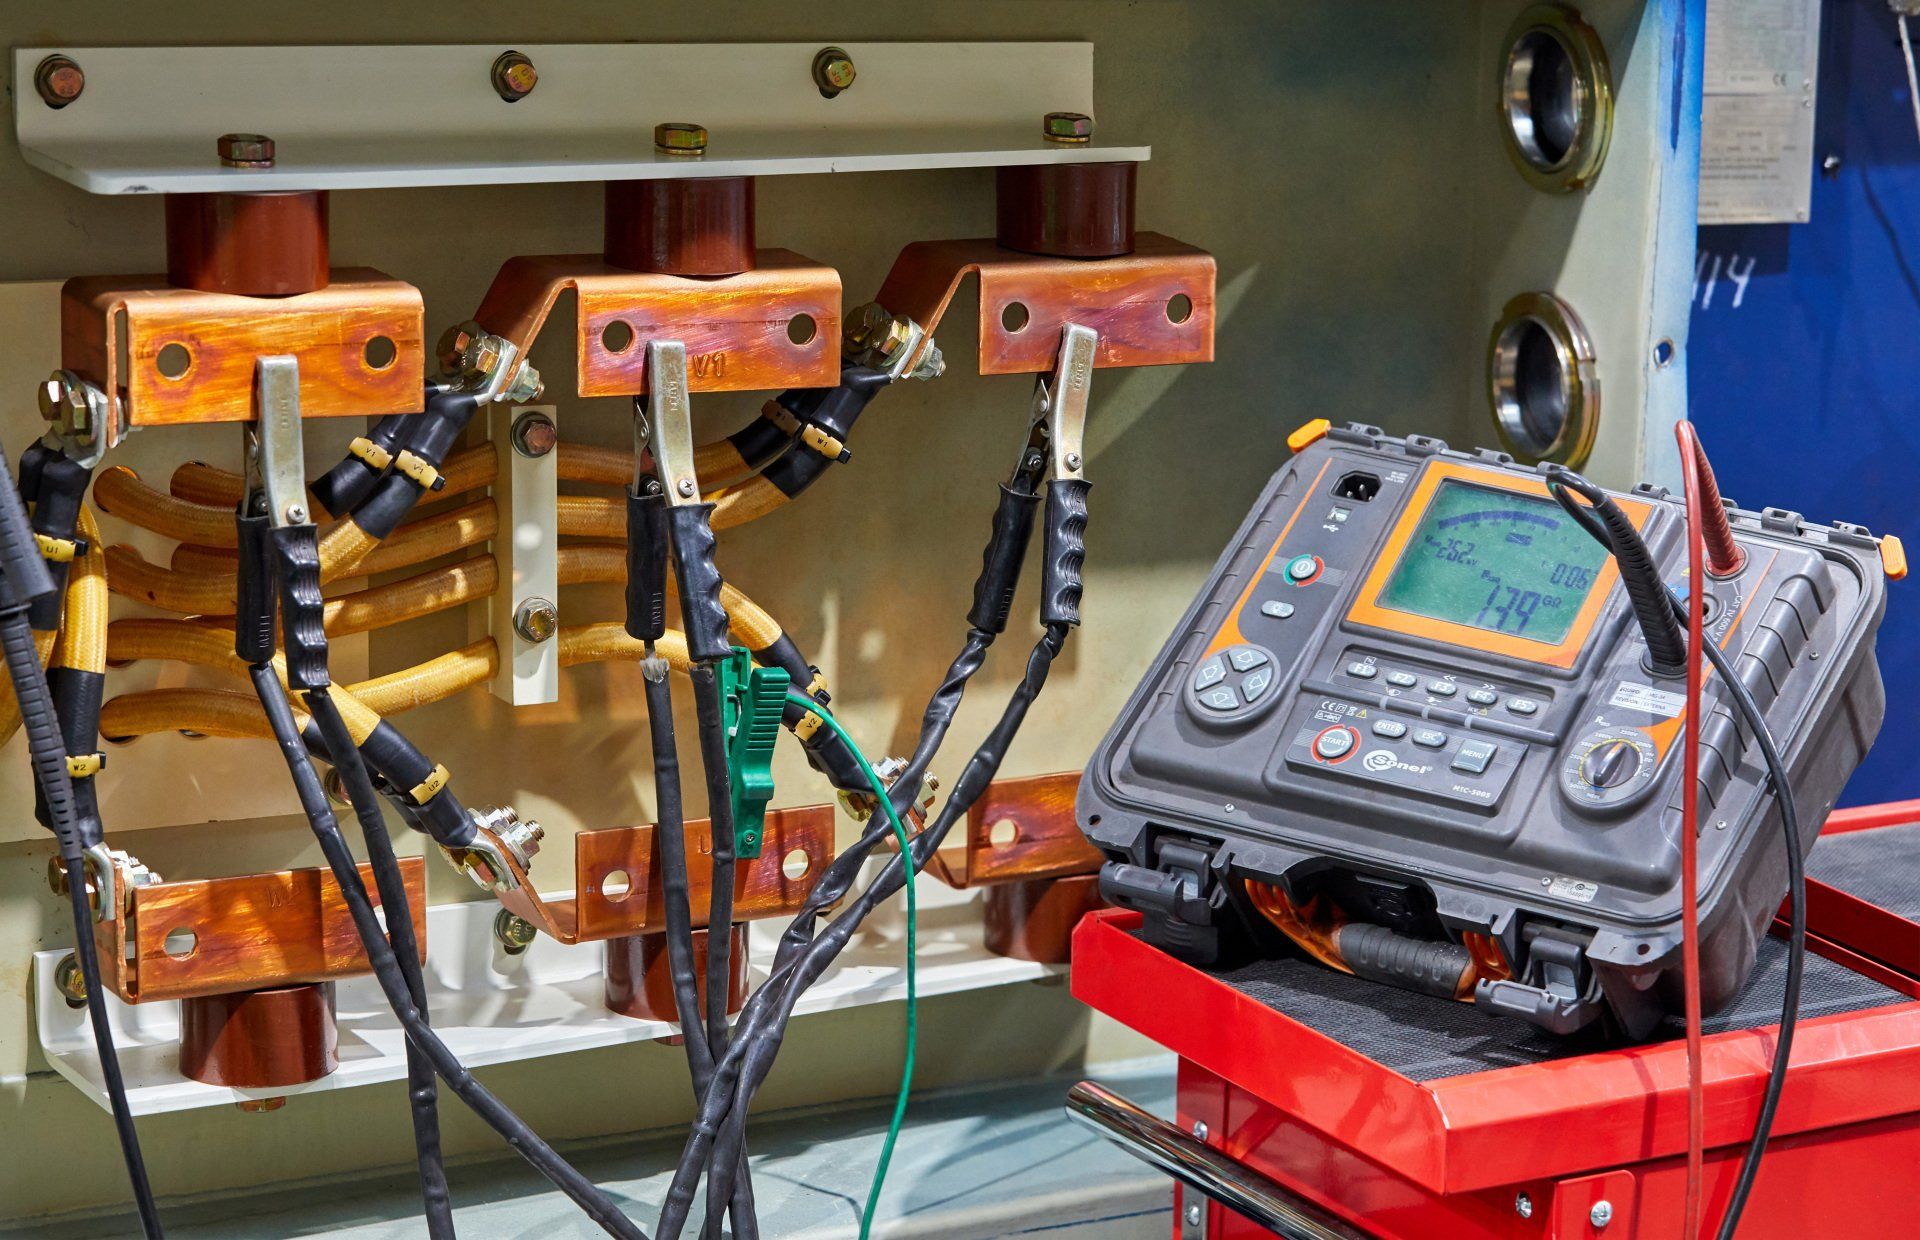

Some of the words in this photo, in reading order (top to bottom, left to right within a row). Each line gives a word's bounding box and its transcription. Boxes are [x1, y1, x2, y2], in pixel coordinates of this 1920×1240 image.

[692, 352, 728, 378] V1
[817, 437, 828, 448] W1
[365, 447, 377, 458] V1
[413, 464, 424, 475] V1
[46, 545, 59, 554] U1
[1355, 664, 1367, 674] F1
[806, 718, 817, 728] V2
[1376, 720, 1401, 734] ENTER
[1422, 731, 1438, 741] ESC
[1322, 737, 1348, 747] START
[1461, 749, 1485, 759] MENU
[429, 780, 440, 792] U2
